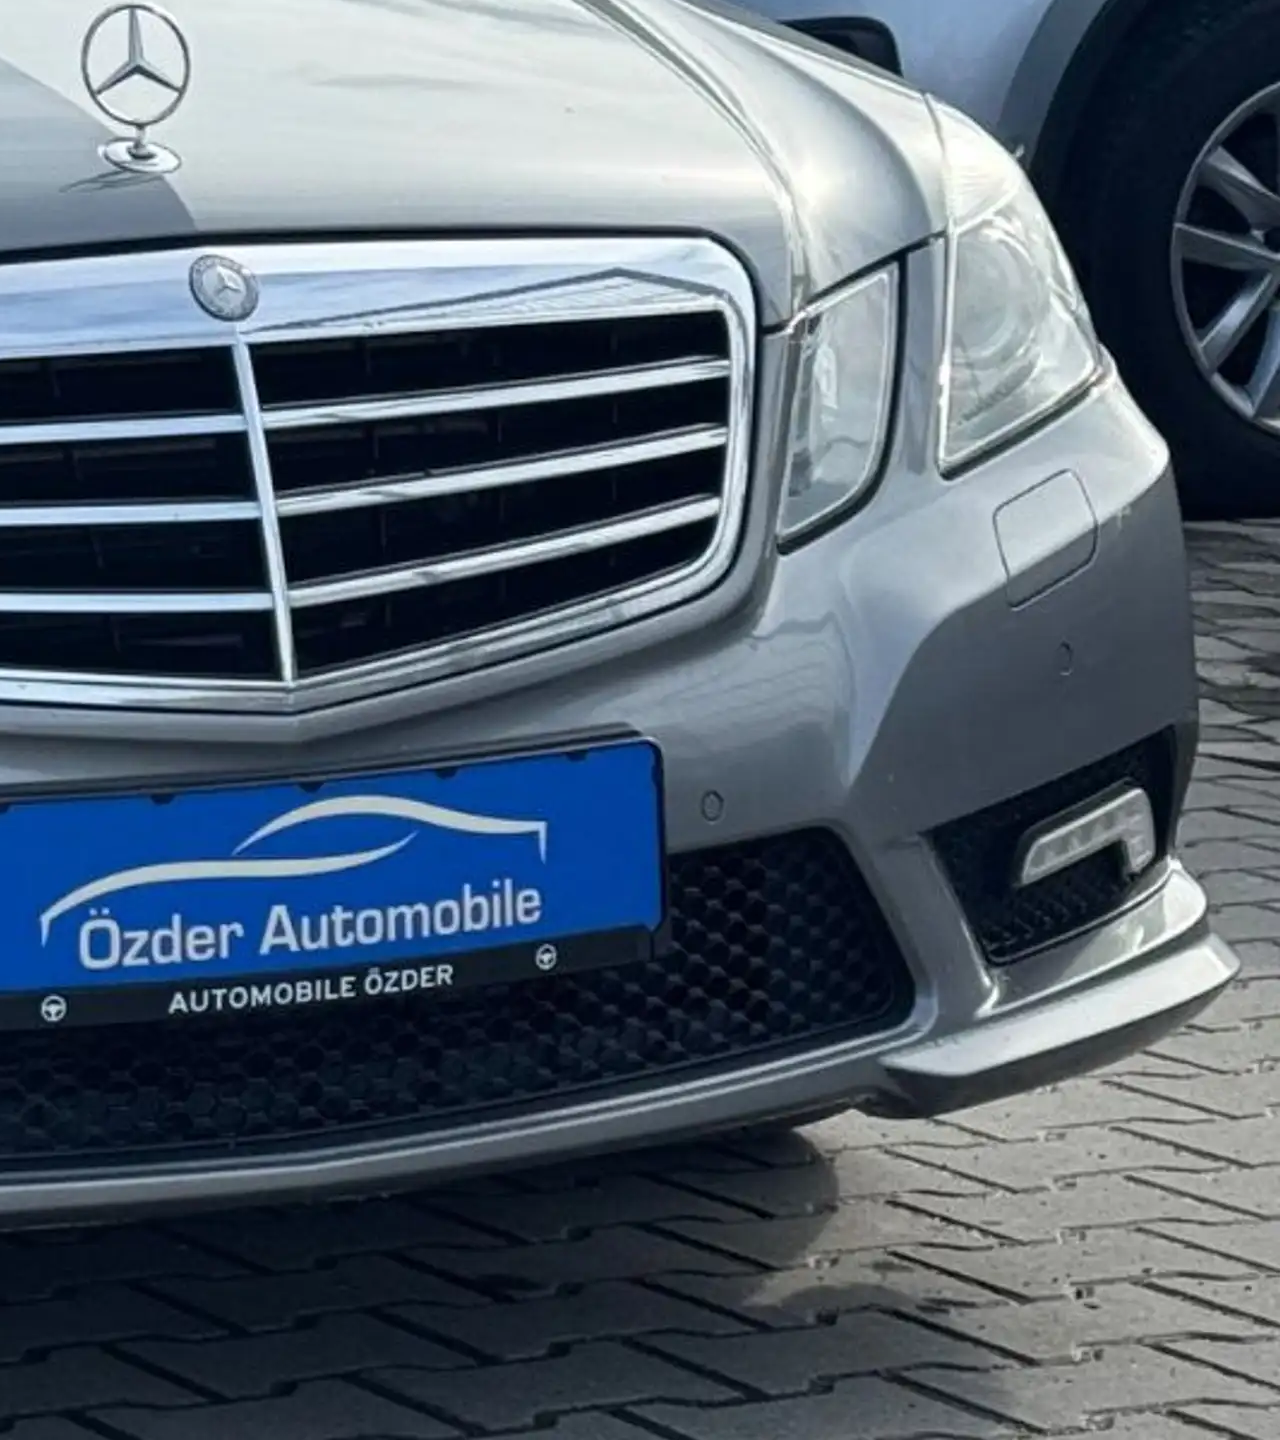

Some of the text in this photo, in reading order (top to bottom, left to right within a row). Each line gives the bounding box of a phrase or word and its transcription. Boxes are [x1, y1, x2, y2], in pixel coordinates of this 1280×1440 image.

[79, 877, 542, 970] Özder Automobile
[168, 964, 454, 1015] AUTOMOBILE ÖZDER
